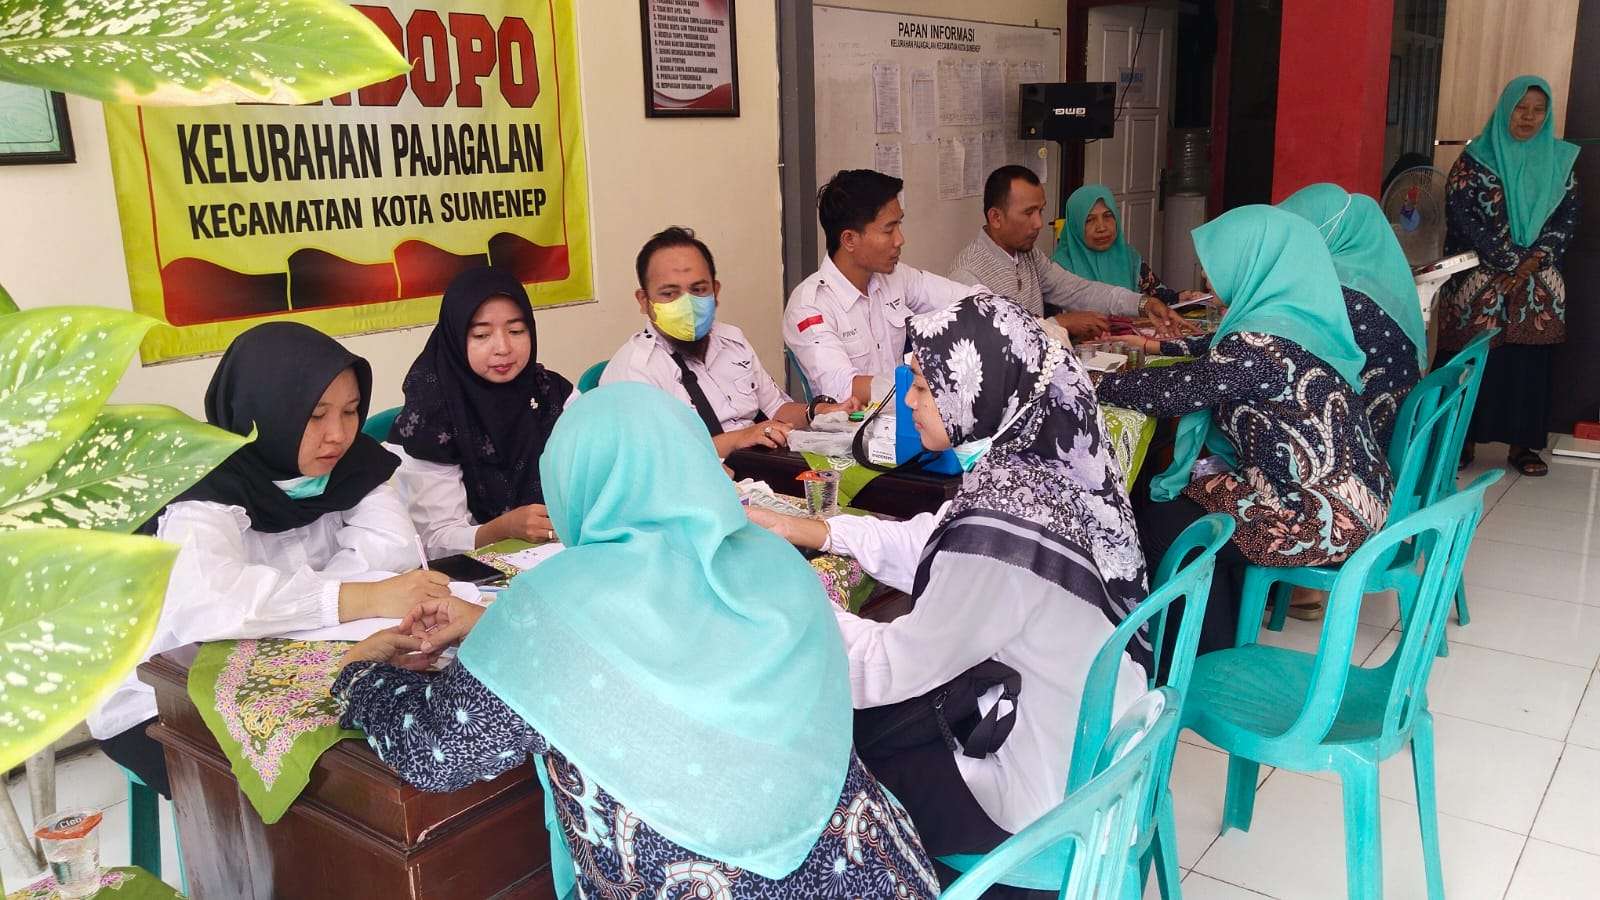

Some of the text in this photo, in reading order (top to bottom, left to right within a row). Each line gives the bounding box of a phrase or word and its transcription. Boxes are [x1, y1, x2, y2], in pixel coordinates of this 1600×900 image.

[235, 3, 541, 108] DOPO
[898, 22, 975, 42] PAPAN INFORMASI
[176, 122, 544, 185] KELURAHAN PAJAGALAN
[188, 188, 547, 240] KECAMATAN KOTA SUMENEP
